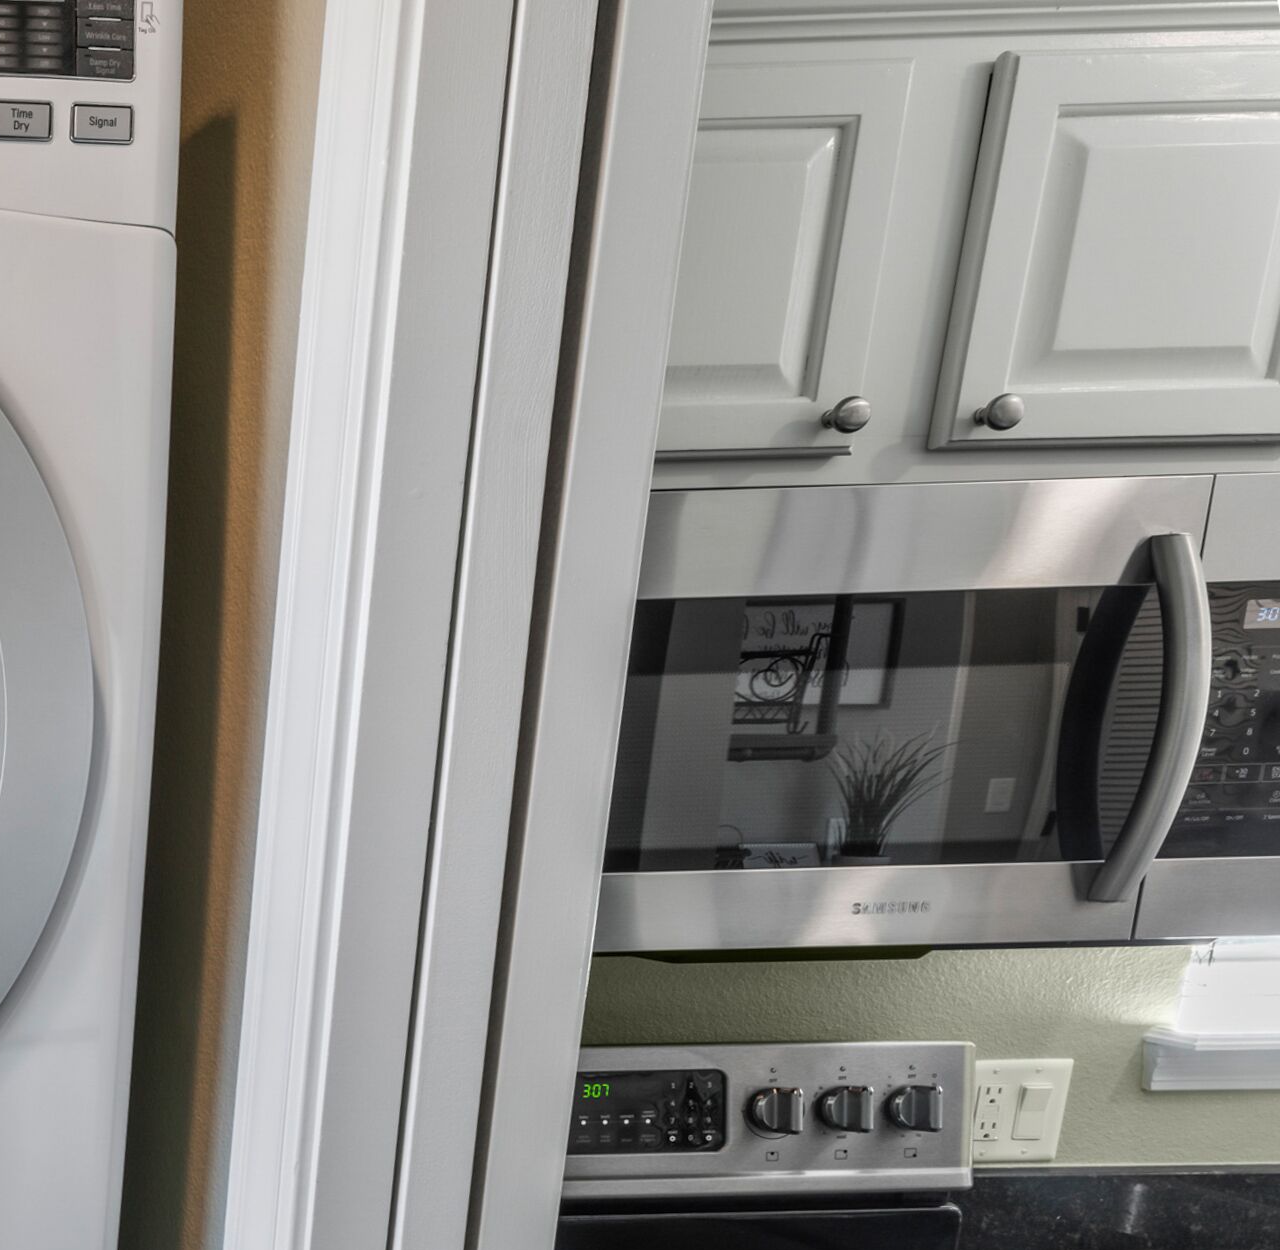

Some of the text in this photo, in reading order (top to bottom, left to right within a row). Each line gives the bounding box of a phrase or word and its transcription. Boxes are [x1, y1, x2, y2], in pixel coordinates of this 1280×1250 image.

[11, 108, 33, 119] Time
[13, 121, 30, 133] Dry
[89, 116, 118, 128] Signal
[1254, 689, 1261, 697] 2
[1210, 728, 1216, 737] 7
[852, 901, 931, 915] SAMSUNG
